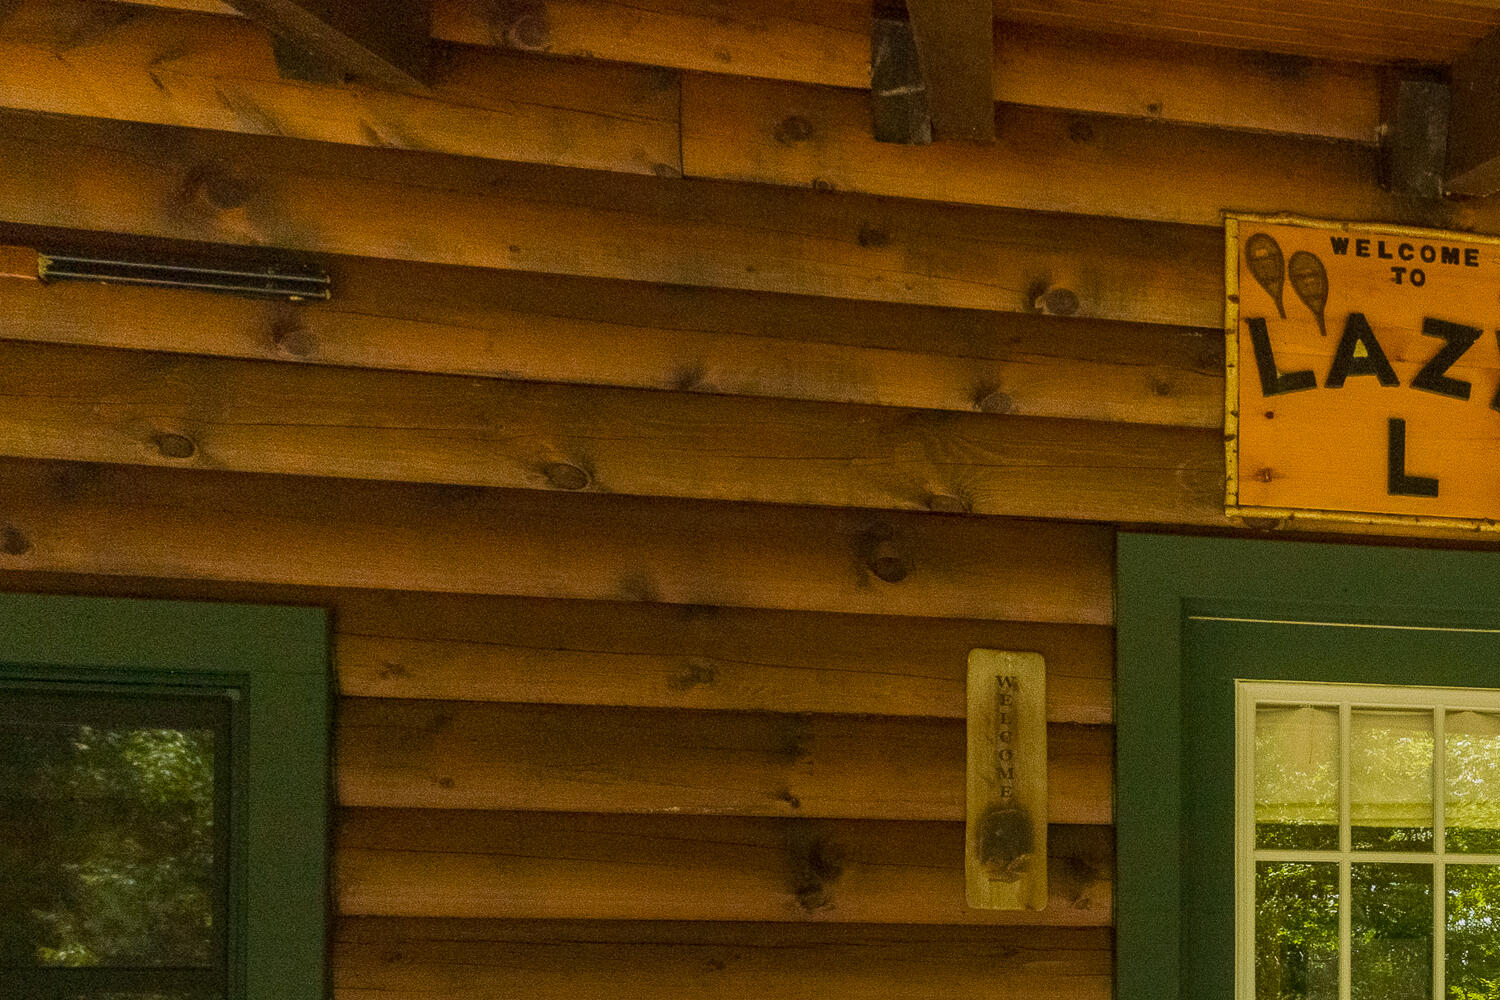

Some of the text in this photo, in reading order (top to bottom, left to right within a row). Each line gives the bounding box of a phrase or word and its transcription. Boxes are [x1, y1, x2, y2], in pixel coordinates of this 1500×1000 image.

[1330, 236, 1480, 267] WELCOME
[1391, 266, 1426, 287] TO
[1387, 417, 1439, 498] L
[996, 675, 1017, 798] WELCOME
